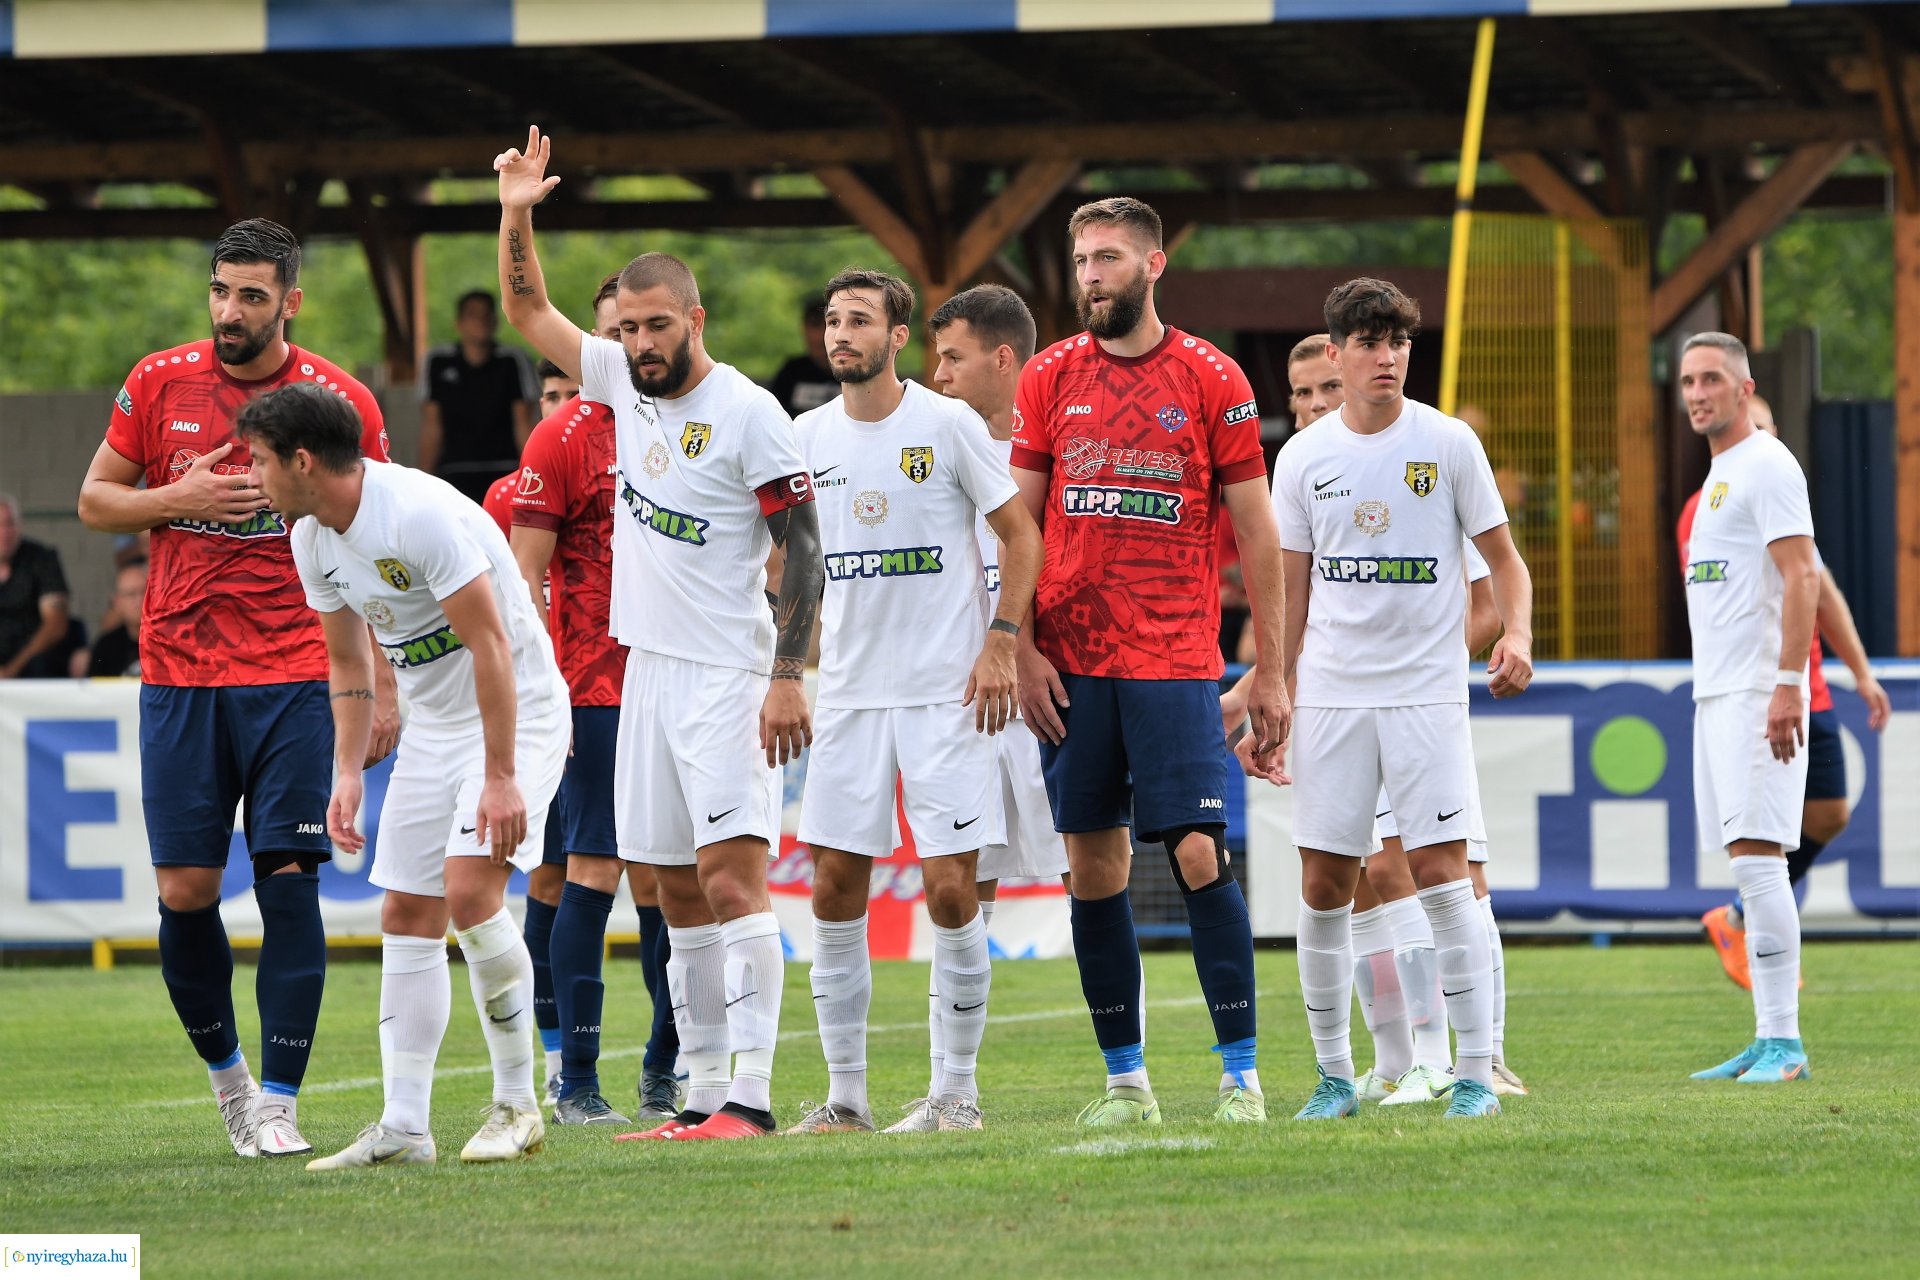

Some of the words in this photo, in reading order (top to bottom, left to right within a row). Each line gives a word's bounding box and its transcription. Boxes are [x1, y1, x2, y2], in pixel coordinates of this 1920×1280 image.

[1064, 405, 1092, 416] JAKO
[170, 420, 200, 433] JAKO
[1199, 798, 1222, 809] JAKO
[296, 823, 324, 835] JAKO
[1213, 1000, 1248, 1012] JAKO
[572, 1025, 600, 1033] JAKO
[270, 1035, 308, 1048] JAKO
